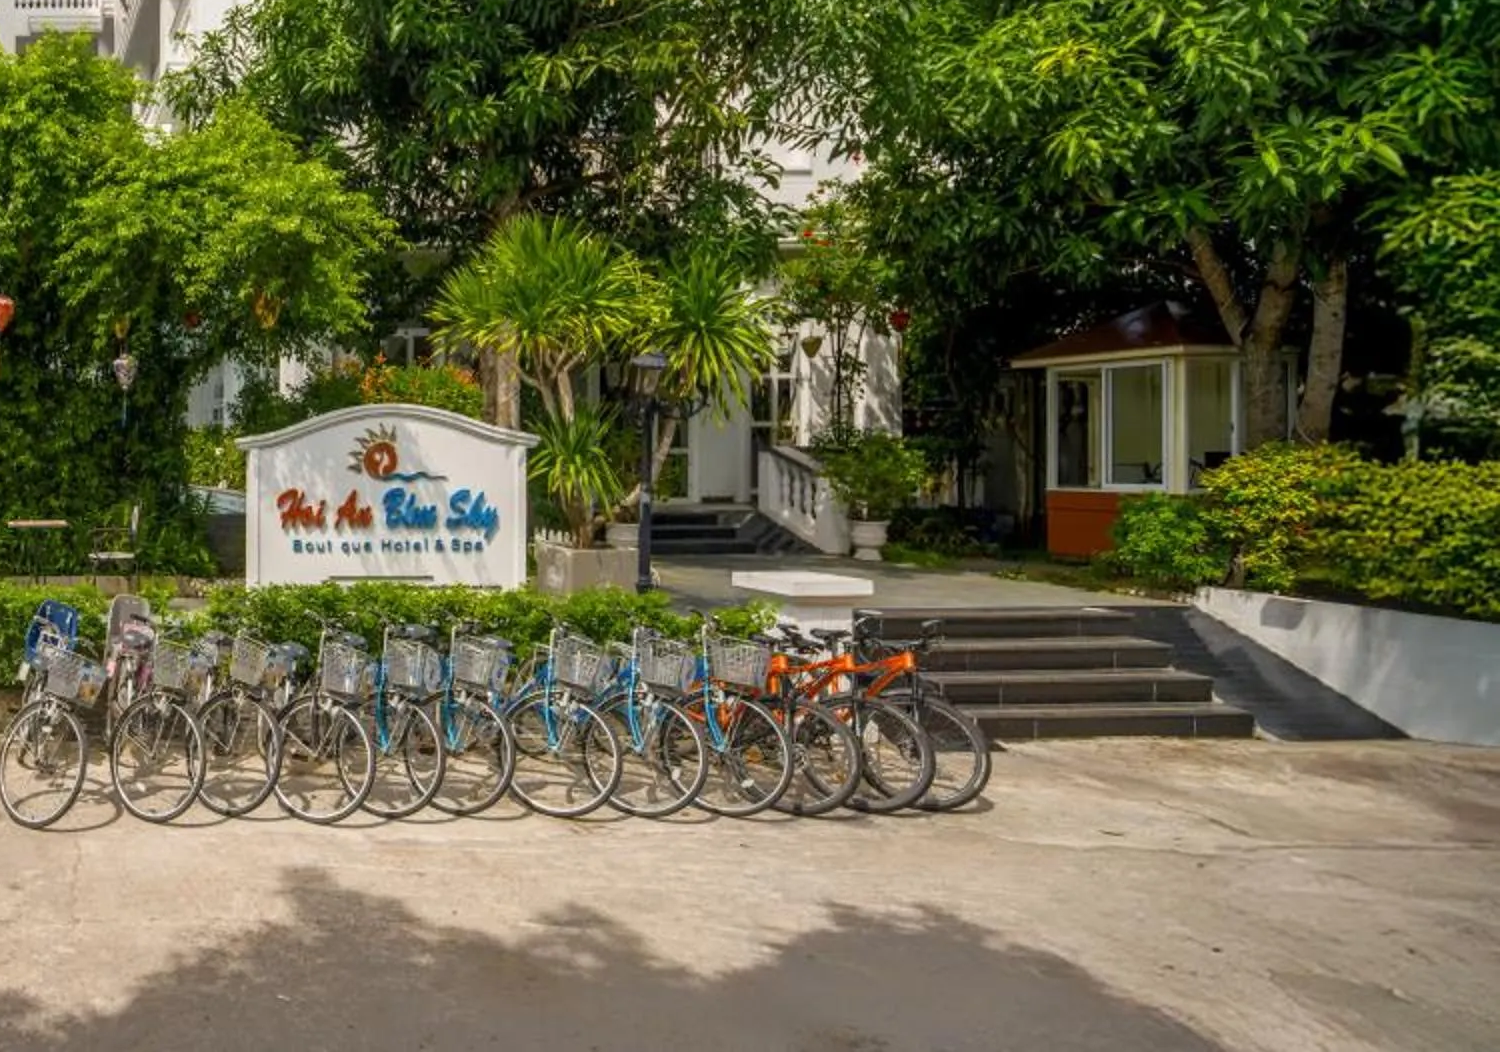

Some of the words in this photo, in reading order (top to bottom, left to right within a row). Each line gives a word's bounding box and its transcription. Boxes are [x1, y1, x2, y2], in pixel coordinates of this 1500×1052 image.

[277, 488, 325, 529] Hoi
[335, 489, 373, 529] An
[383, 487, 437, 529] Blue
[446, 489, 498, 545] Sky
[293, 539, 373, 556] Boutque
[381, 538, 429, 553] Hotel
[451, 539, 484, 554] Spa
